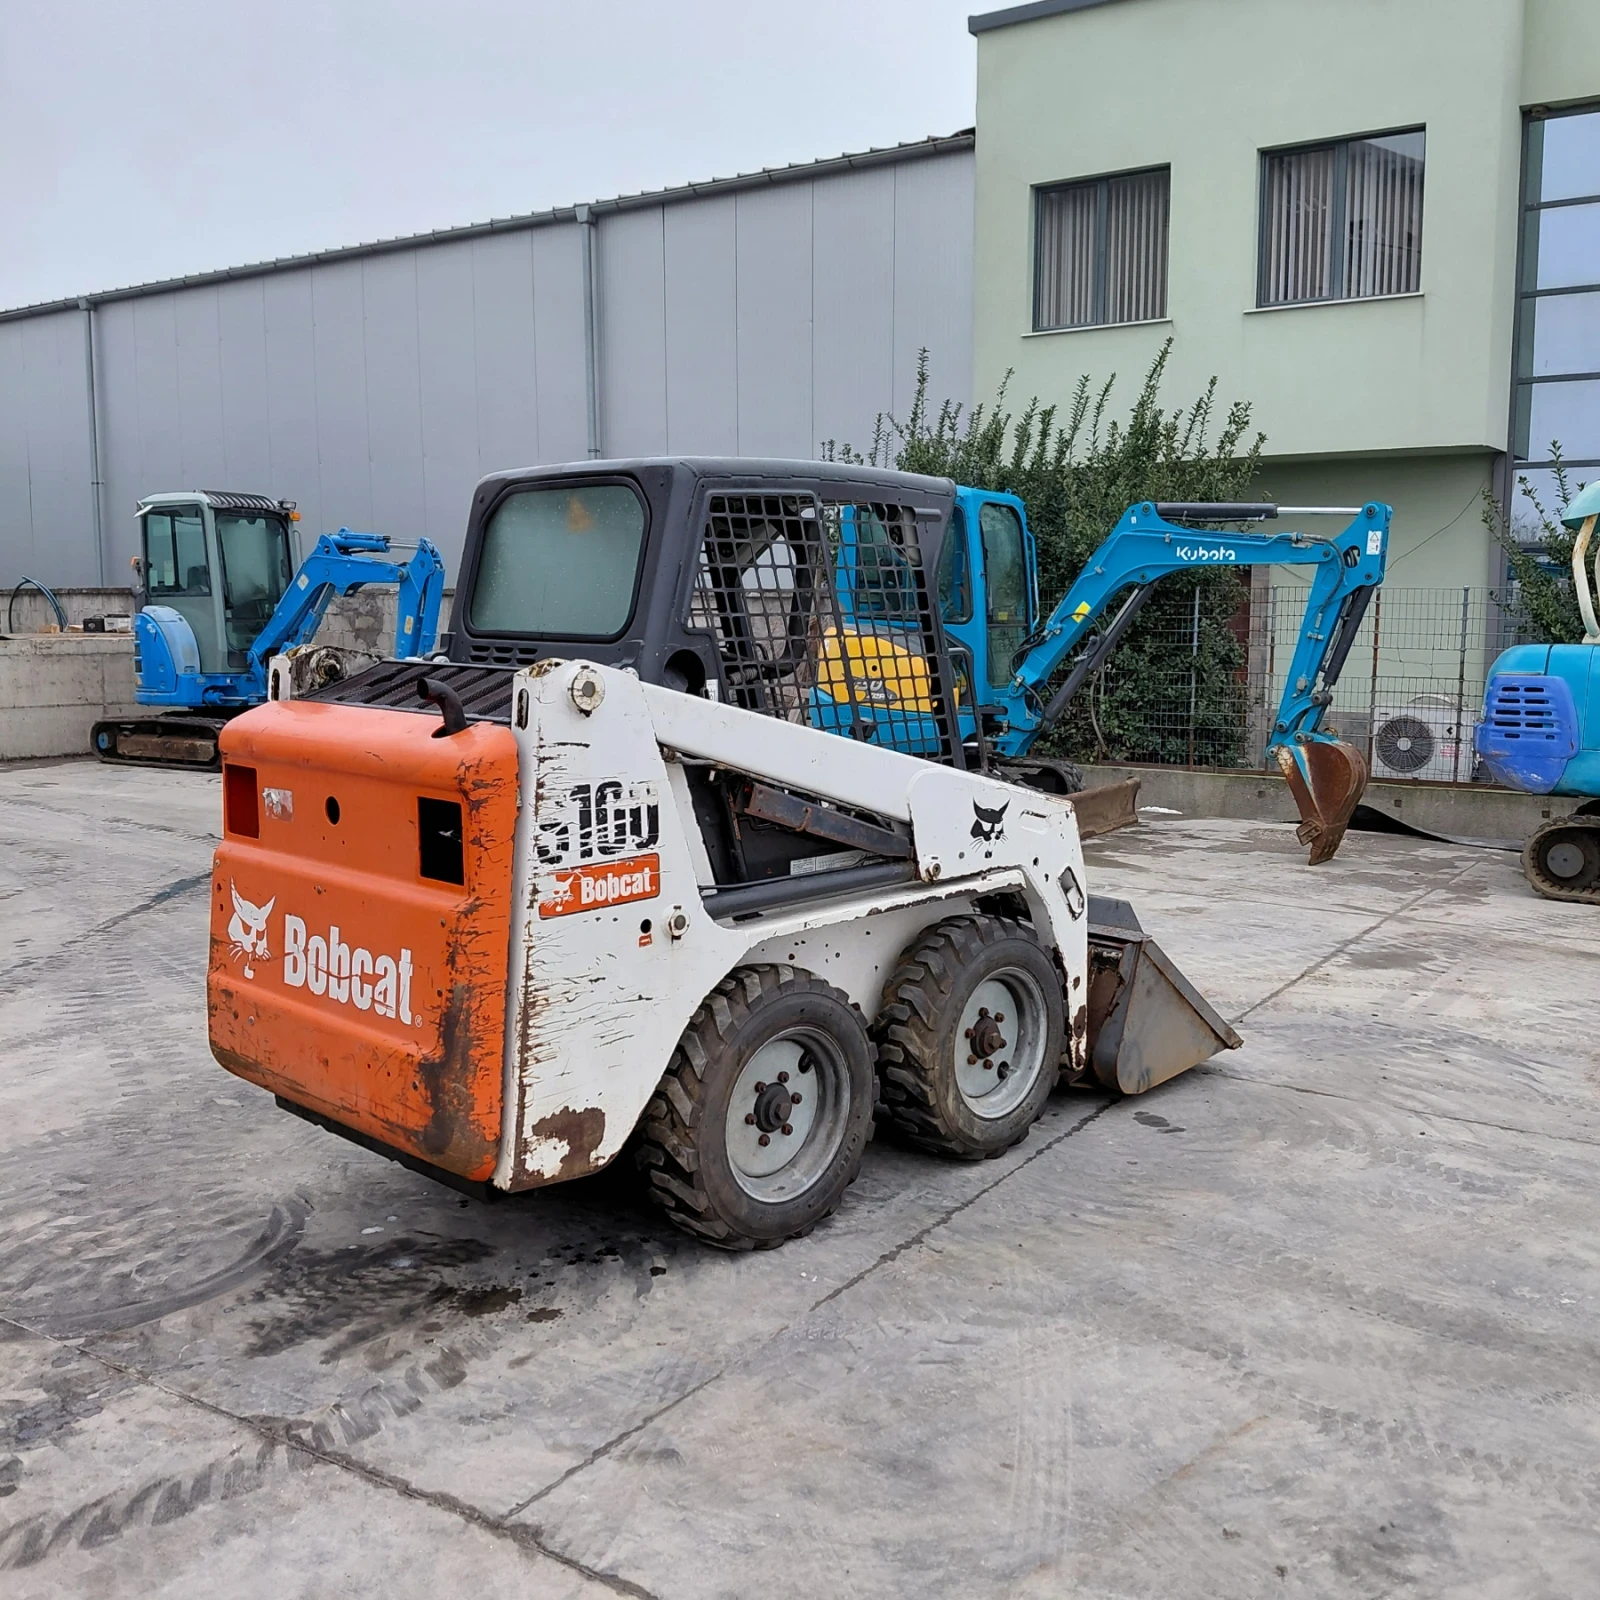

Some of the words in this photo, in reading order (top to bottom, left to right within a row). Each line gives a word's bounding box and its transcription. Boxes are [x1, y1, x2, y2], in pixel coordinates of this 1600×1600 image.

[1176, 546, 1236, 561] Kubota
[580, 866, 652, 905] Bobcat
[283, 913, 414, 1026] Bobcat
